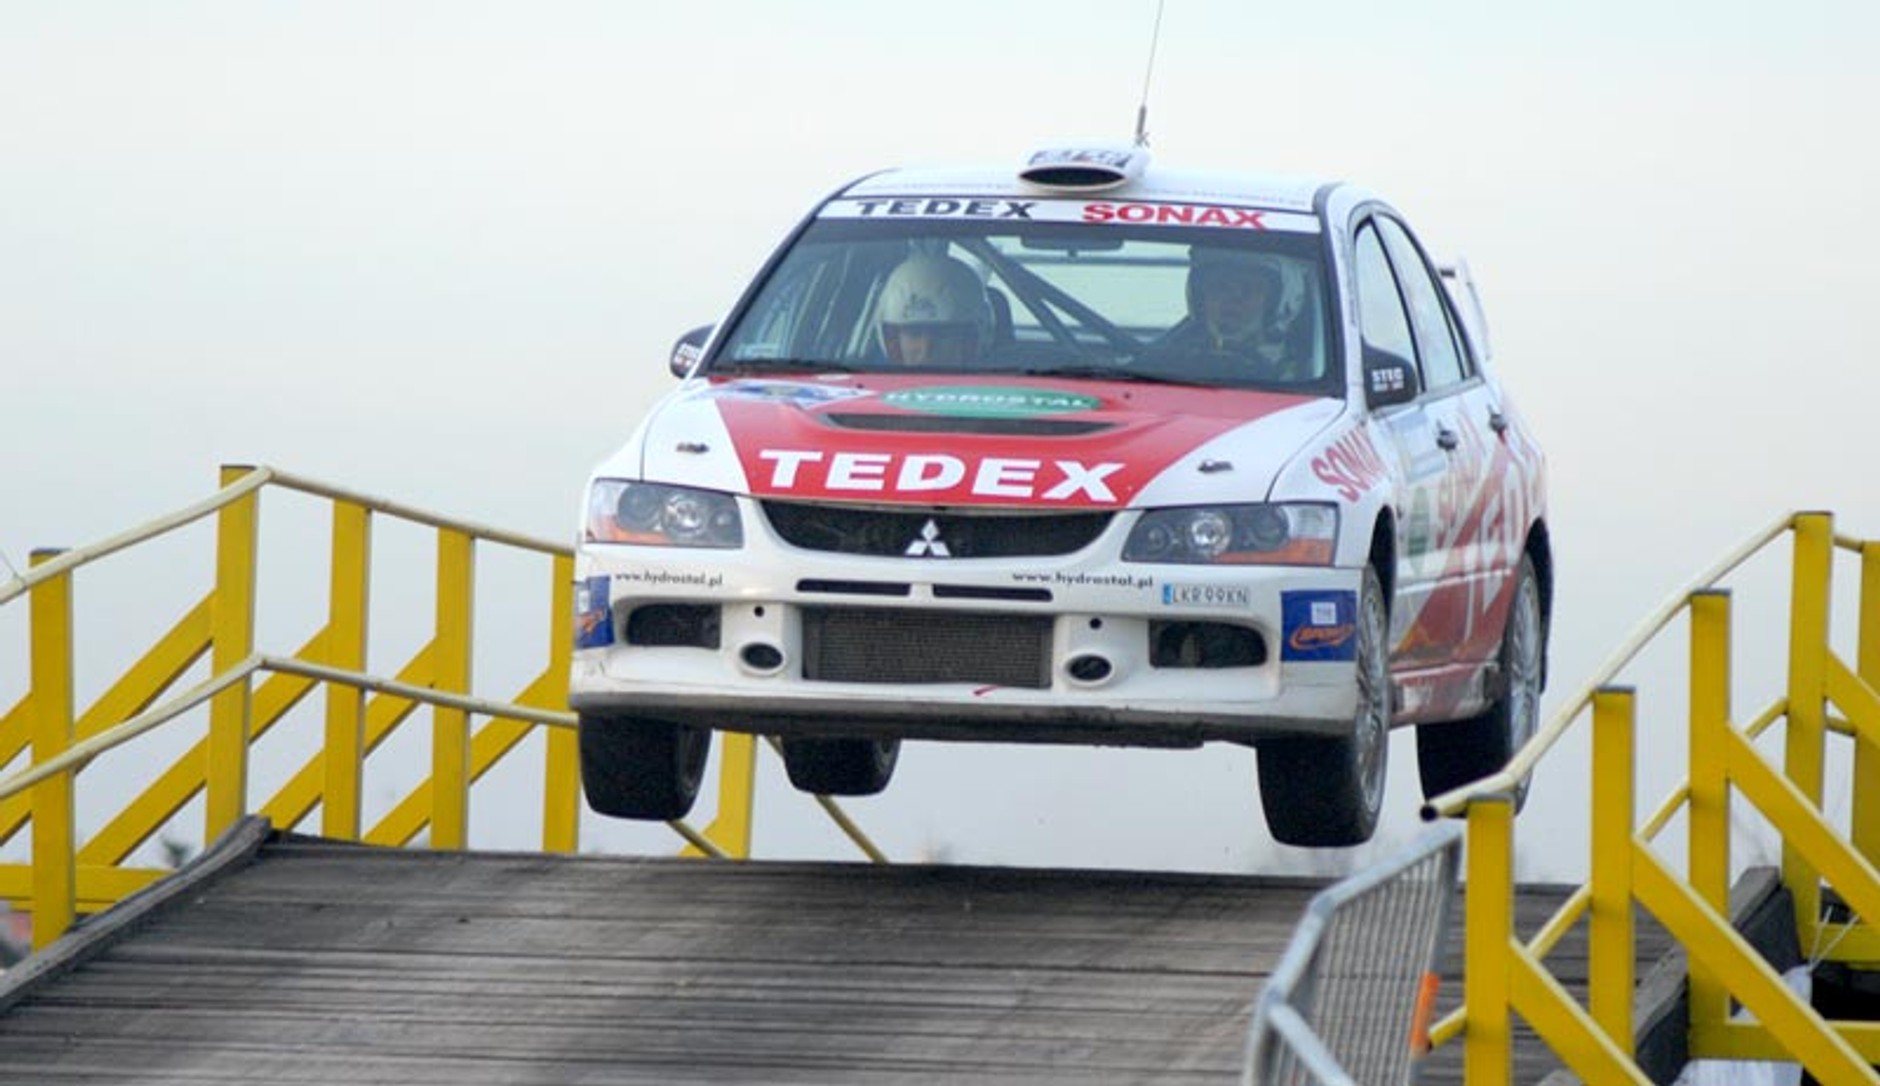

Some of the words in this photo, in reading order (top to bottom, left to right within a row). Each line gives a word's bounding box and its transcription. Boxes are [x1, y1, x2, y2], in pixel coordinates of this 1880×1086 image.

[857, 200, 1036, 220] TEDEX
[1081, 202, 1267, 230] SONAX
[884, 390, 1093, 411] HYDROSTAL
[758, 448, 1125, 502] TEDEX
[615, 570, 723, 587] www.hydrostal.pl
[1012, 571, 1153, 590] www.hydrostal.pl
